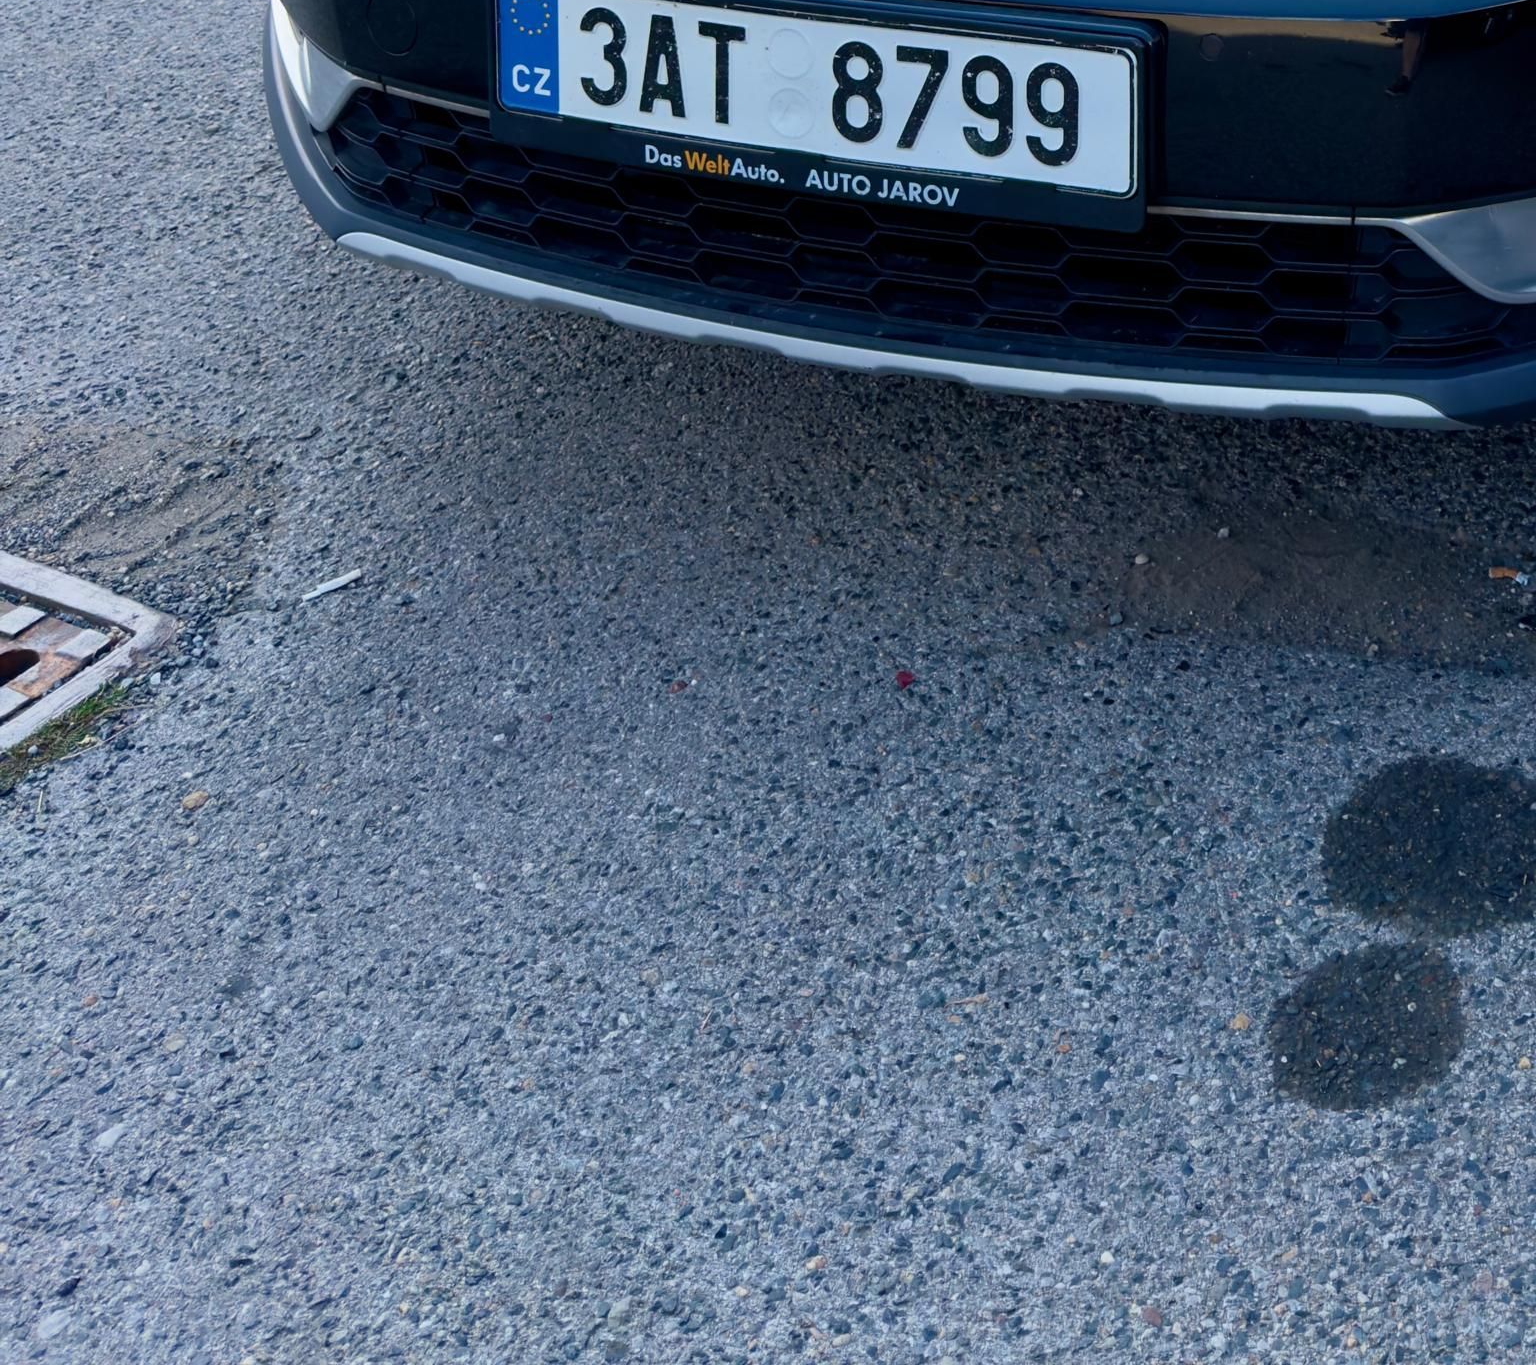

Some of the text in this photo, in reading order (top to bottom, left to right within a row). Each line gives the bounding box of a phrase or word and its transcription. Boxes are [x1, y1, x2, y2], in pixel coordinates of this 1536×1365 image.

[512, 64, 551, 96] CZ
[580, 7, 1079, 166] 3AT 8799
[644, 144, 682, 168] Das
[805, 169, 960, 207] AUTO JAROV
